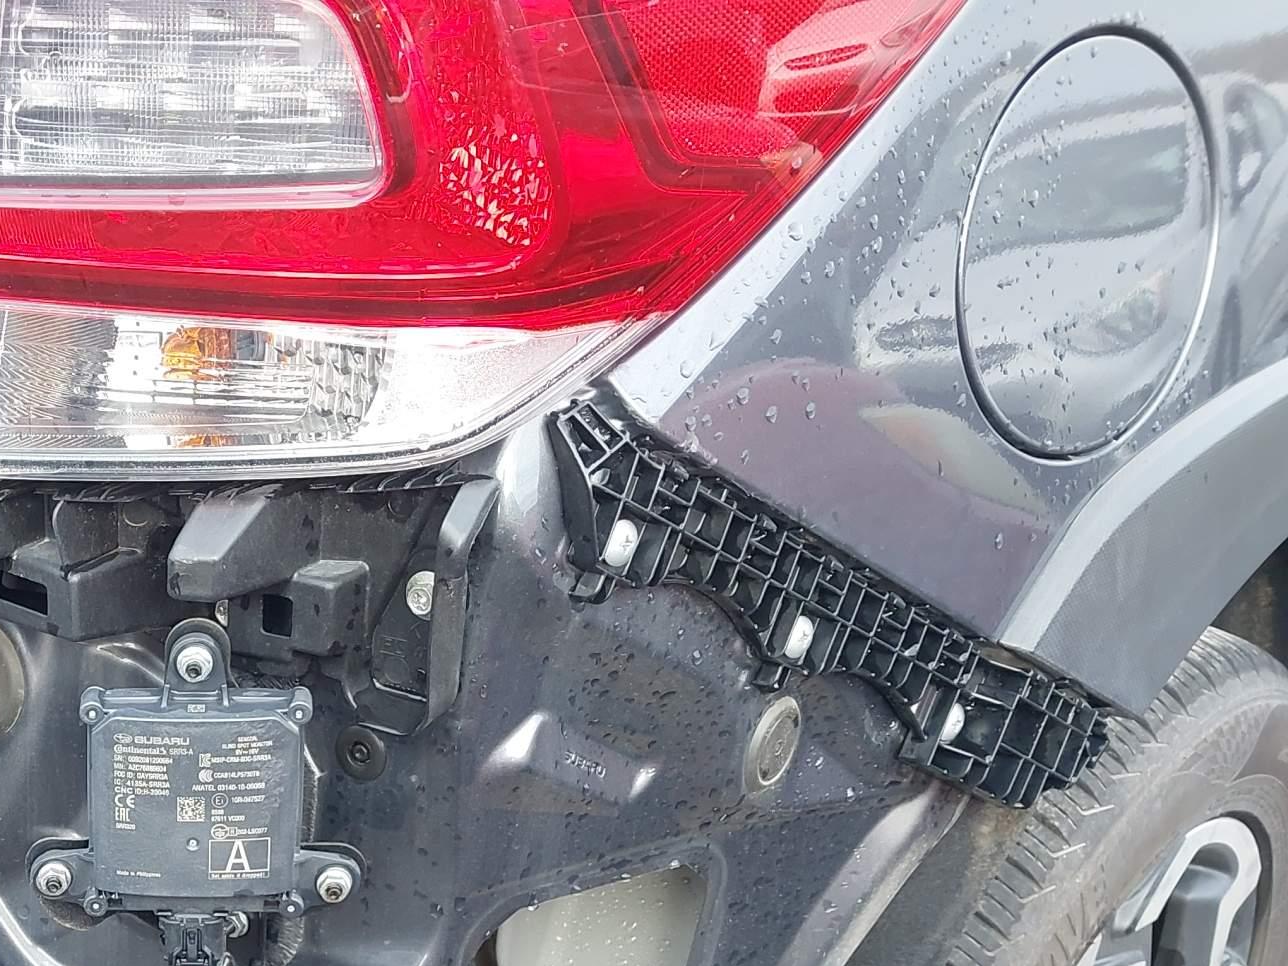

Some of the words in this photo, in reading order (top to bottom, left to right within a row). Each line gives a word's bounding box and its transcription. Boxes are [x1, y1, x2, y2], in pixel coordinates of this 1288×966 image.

[133, 735, 190, 746] SUBARU
[113, 744, 160, 755] Continental
[114, 786, 133, 794] CNC
[191, 784, 216, 792] ANATEL
[114, 794, 135, 809] CE
[225, 840, 251, 872] A
